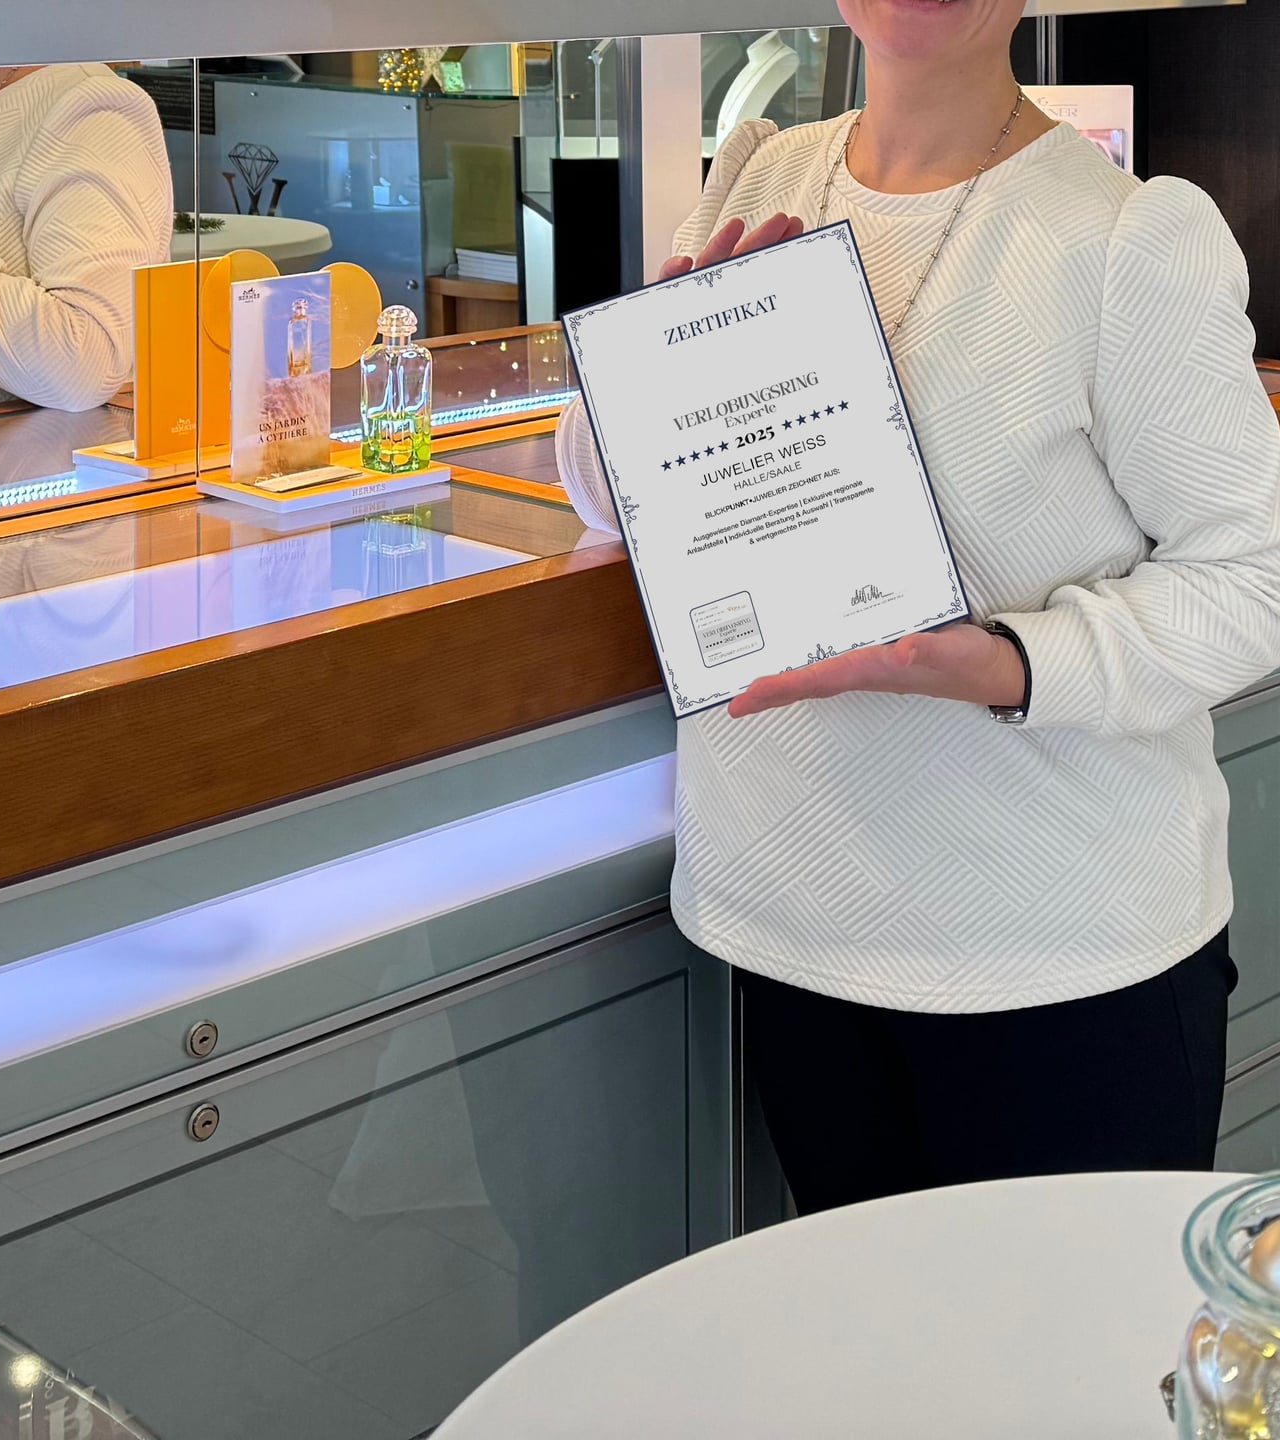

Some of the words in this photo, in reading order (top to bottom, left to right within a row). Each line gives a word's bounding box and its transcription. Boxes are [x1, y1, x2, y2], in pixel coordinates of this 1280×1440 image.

[664, 294, 777, 345] ZERTIFIKAT
[673, 371, 820, 431] VERLOBUNGSRING
[724, 403, 777, 428] Experte
[259, 422, 272, 433] UN
[274, 416, 308, 432] JARDIN
[735, 426, 776, 448] 2025
[700, 452, 776, 487] JUWELIER
[778, 434, 827, 459] WEISS
[733, 461, 803, 491] HALLE/SAALE
[788, 474, 822, 491] ZEICHNET
[823, 468, 841, 480] AUS:
[686, 539, 724, 556] Anlaufstelle
[728, 524, 765, 542] Individuelle
[765, 513, 795, 529] Beratung
[802, 501, 829, 516] Auswahl
[832, 486, 875, 505] Transparente
[693, 522, 739, 544] Ausgewiesene
[740, 502, 799, 527] Diamant-Expertise
[802, 489, 833, 506] Exklusive
[834, 479, 863, 495] regionale
[755, 524, 798, 544] wertgerechte
[798, 516, 819, 528] Preise
